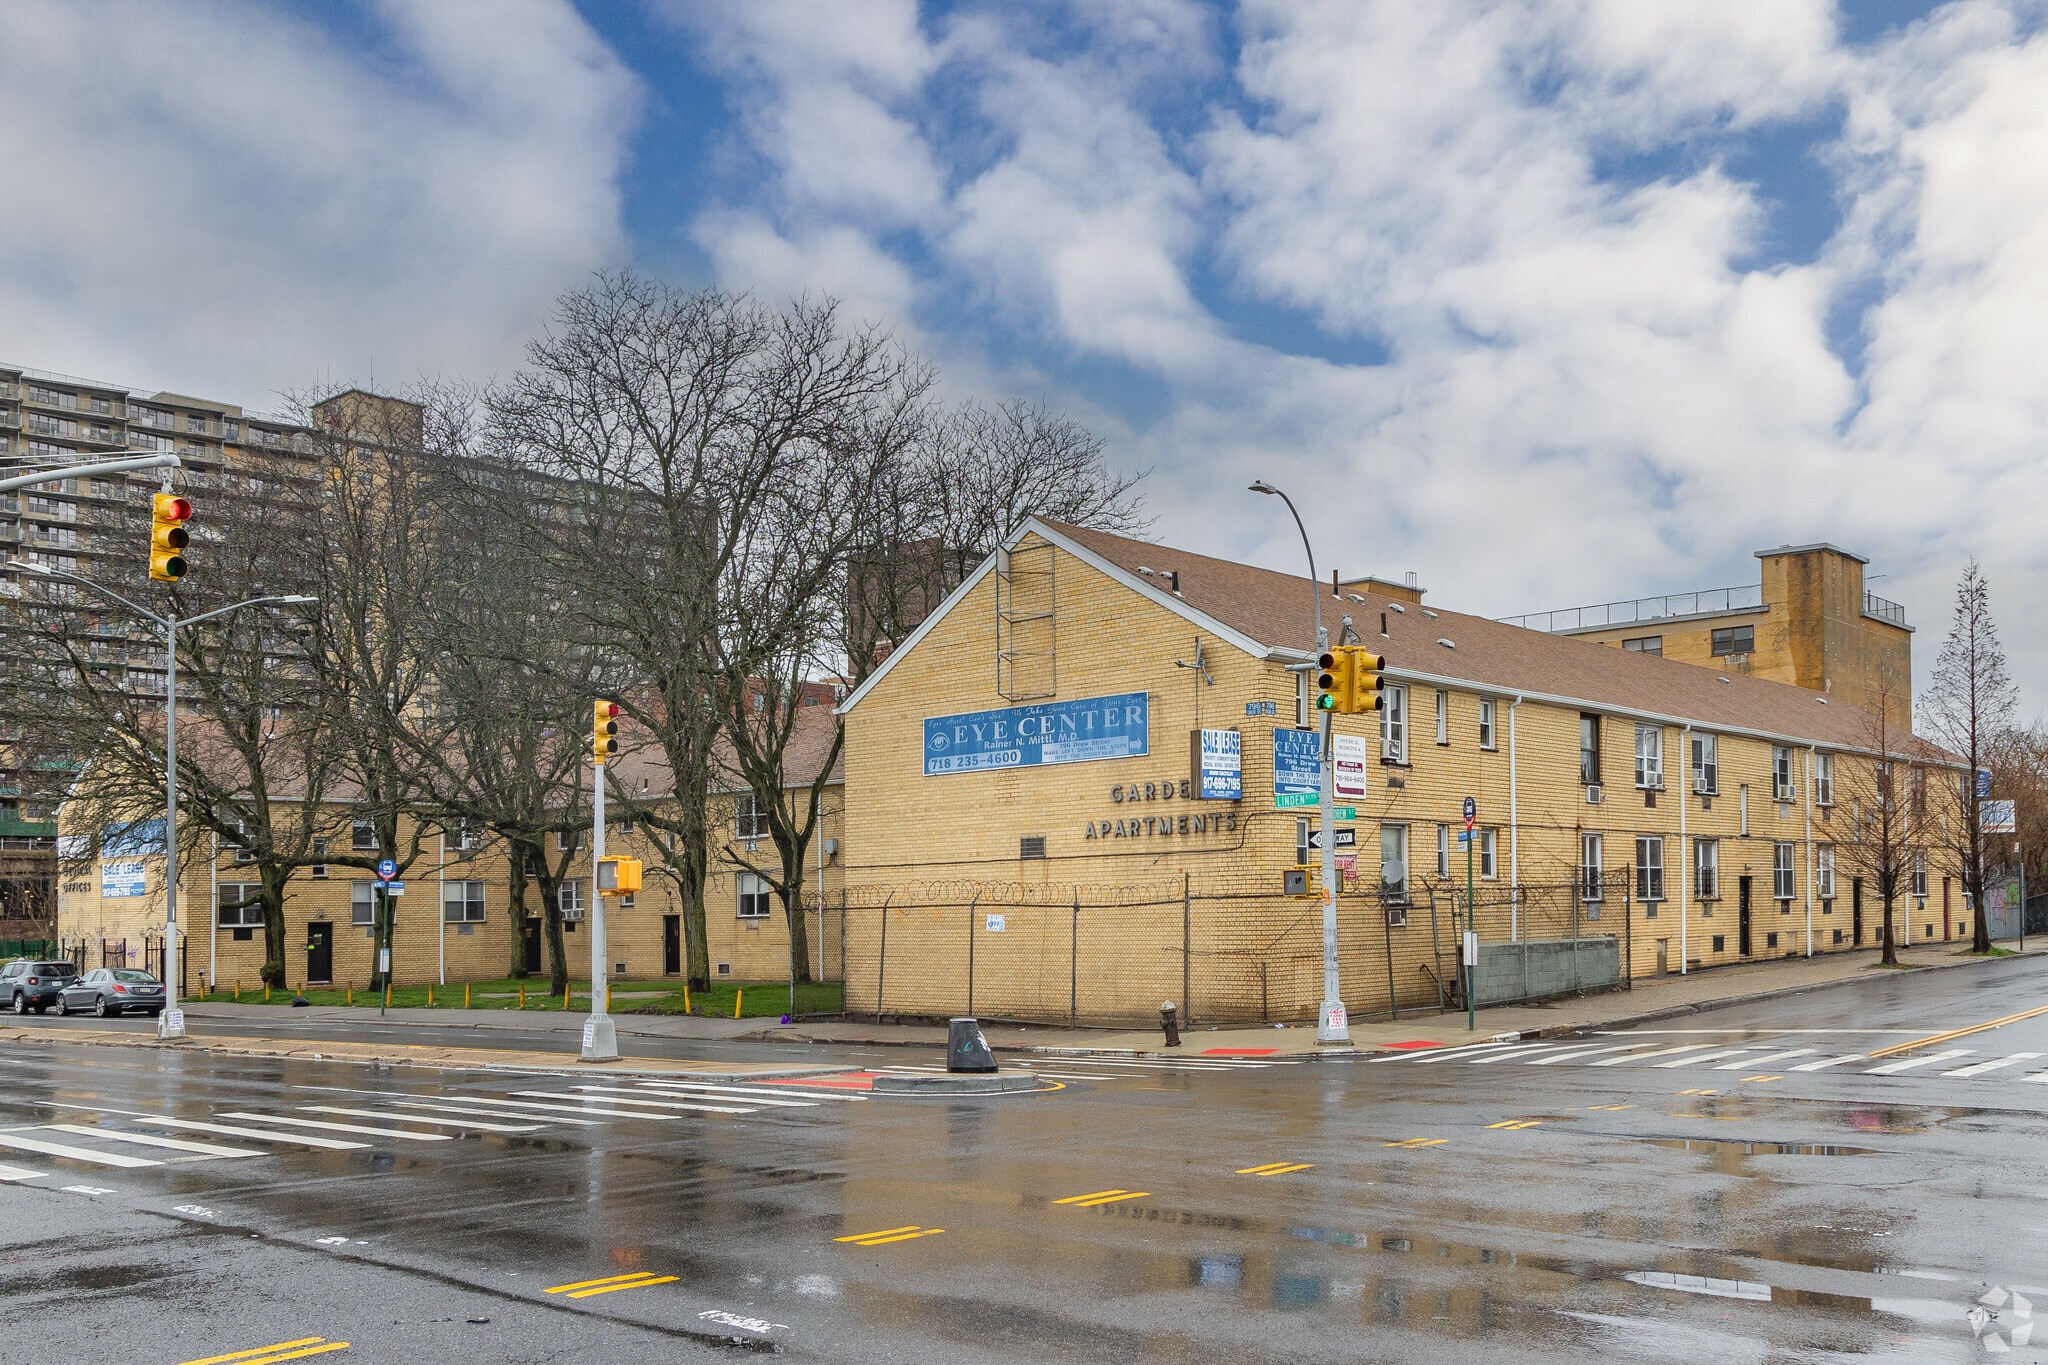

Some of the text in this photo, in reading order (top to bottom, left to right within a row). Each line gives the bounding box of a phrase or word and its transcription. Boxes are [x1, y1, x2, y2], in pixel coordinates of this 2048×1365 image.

[1026, 706, 1043, 716] Take
[1047, 703, 1066, 714] Good
[1090, 700, 1097, 710] of
[1248, 702, 1261, 710] 796
[953, 705, 1144, 744] EYE CENTER
[984, 740, 1012, 750] Rainer
[1015, 738, 1025, 747] N.
[1058, 732, 1080, 742] M.D.
[1222, 732, 1240, 755] LEASE
[1289, 731, 1313, 744] EYE
[1083, 750, 1116, 758] COURTYARD
[1275, 740, 1320, 755] CENTE
[931, 758, 951, 770] 718
[1203, 776, 1240, 790] 917-696-7195
[1110, 780, 1190, 802] GARDE
[1277, 794, 1305, 807] LINDEN
[1333, 808, 1346, 820] DREW
[1084, 812, 1236, 839] APARTMENTS
[1343, 860, 1354, 869] RENT
